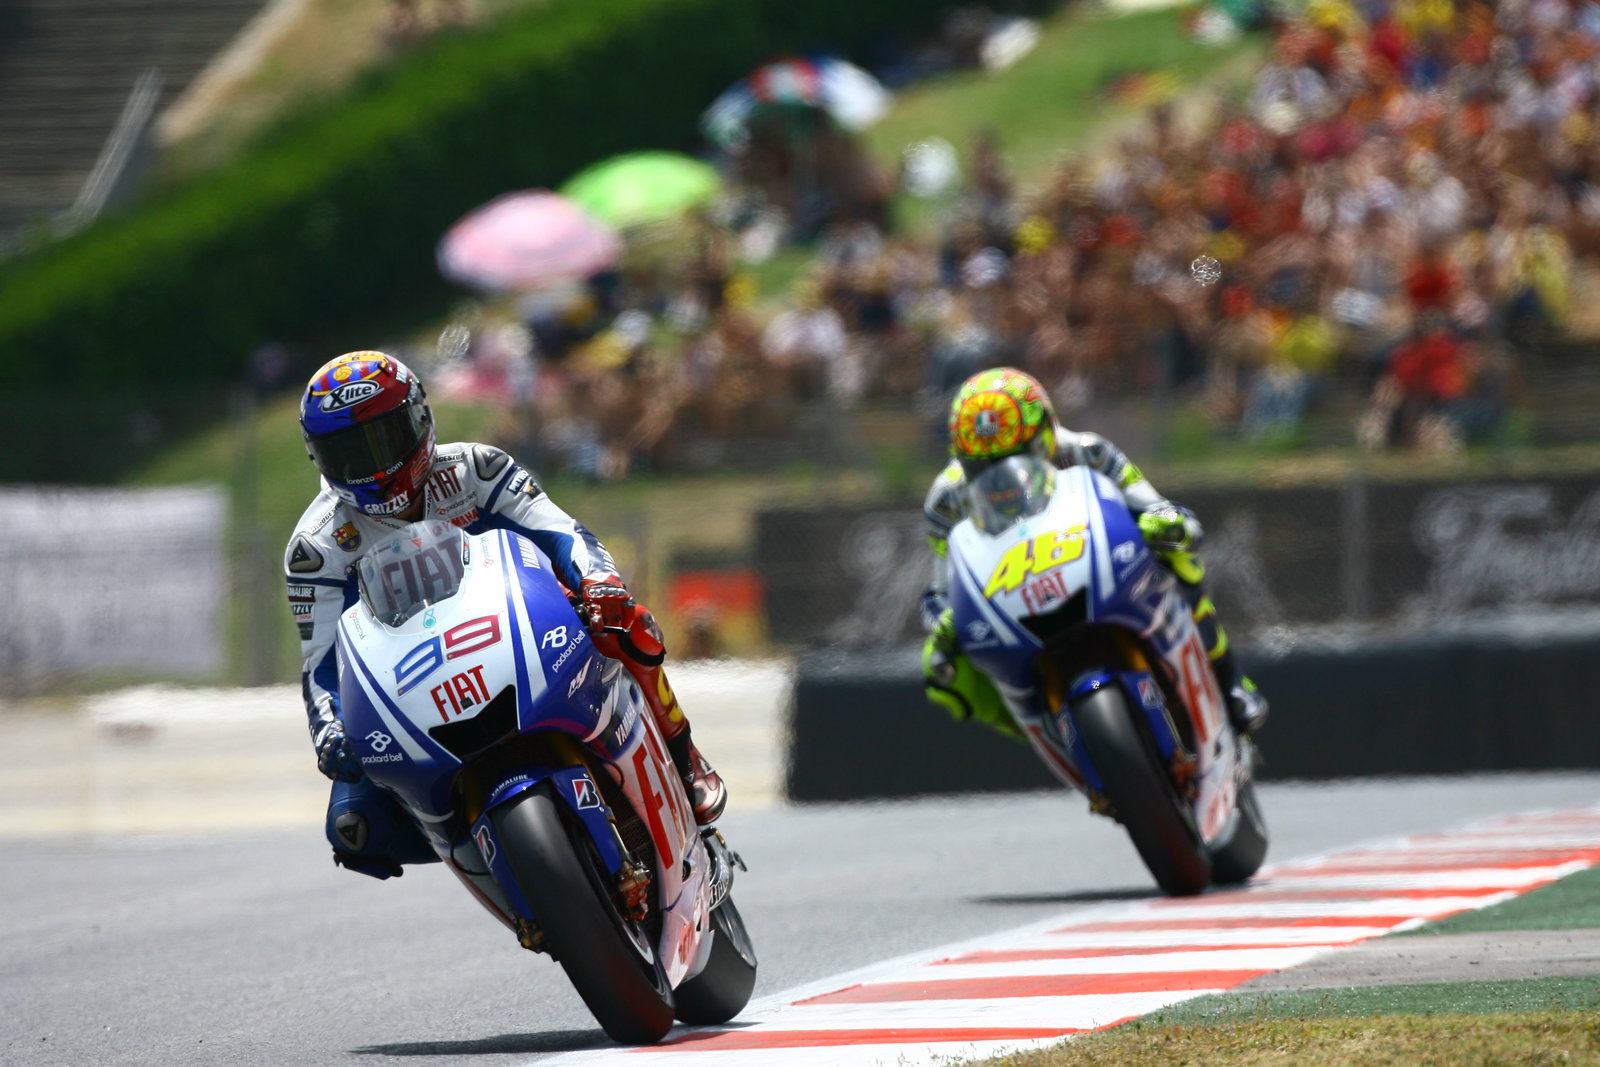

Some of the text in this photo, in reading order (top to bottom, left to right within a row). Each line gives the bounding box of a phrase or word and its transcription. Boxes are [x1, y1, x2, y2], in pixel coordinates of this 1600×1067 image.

[329, 386, 372, 409] X-lite
[364, 490, 409, 515] GRIZZLY
[428, 465, 462, 502] FIAT
[380, 538, 464, 612] FIAT
[982, 522, 1087, 600] 46
[1021, 570, 1070, 616] FIAT
[393, 614, 503, 698] 99
[551, 629, 586, 673] packard bell
[430, 664, 490, 723] FIAT
[361, 752, 403, 764] packard bell
[491, 774, 529, 798] YAMALUBE
